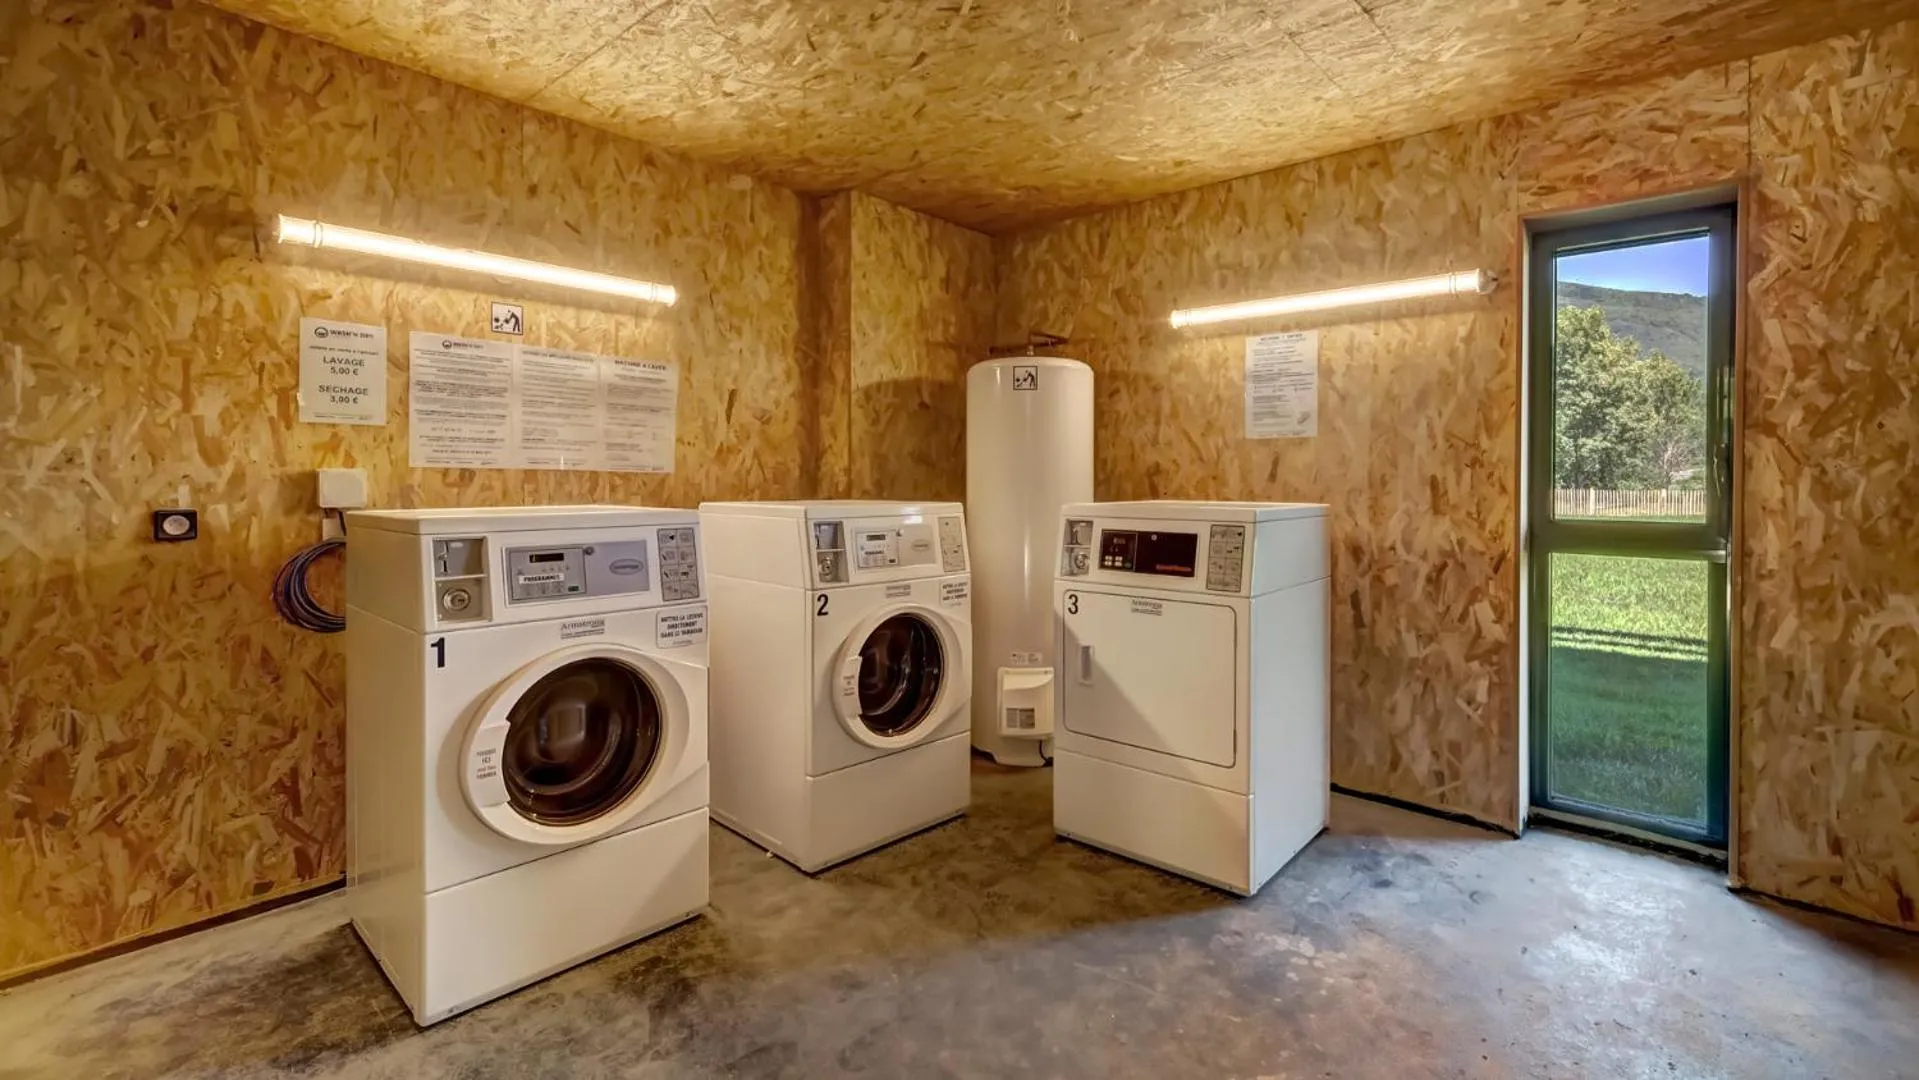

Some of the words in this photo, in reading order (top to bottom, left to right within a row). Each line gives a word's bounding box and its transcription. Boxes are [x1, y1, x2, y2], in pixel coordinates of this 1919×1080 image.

[323, 355, 365, 367] LAVAGE
[330, 367, 350, 376] 5,00
[353, 368, 359, 376] €
[330, 395, 350, 405] 3,00
[353, 396, 359, 404] €
[816, 593, 829, 616] 2
[1067, 593, 1079, 615] 3
[430, 636, 446, 668] 1
